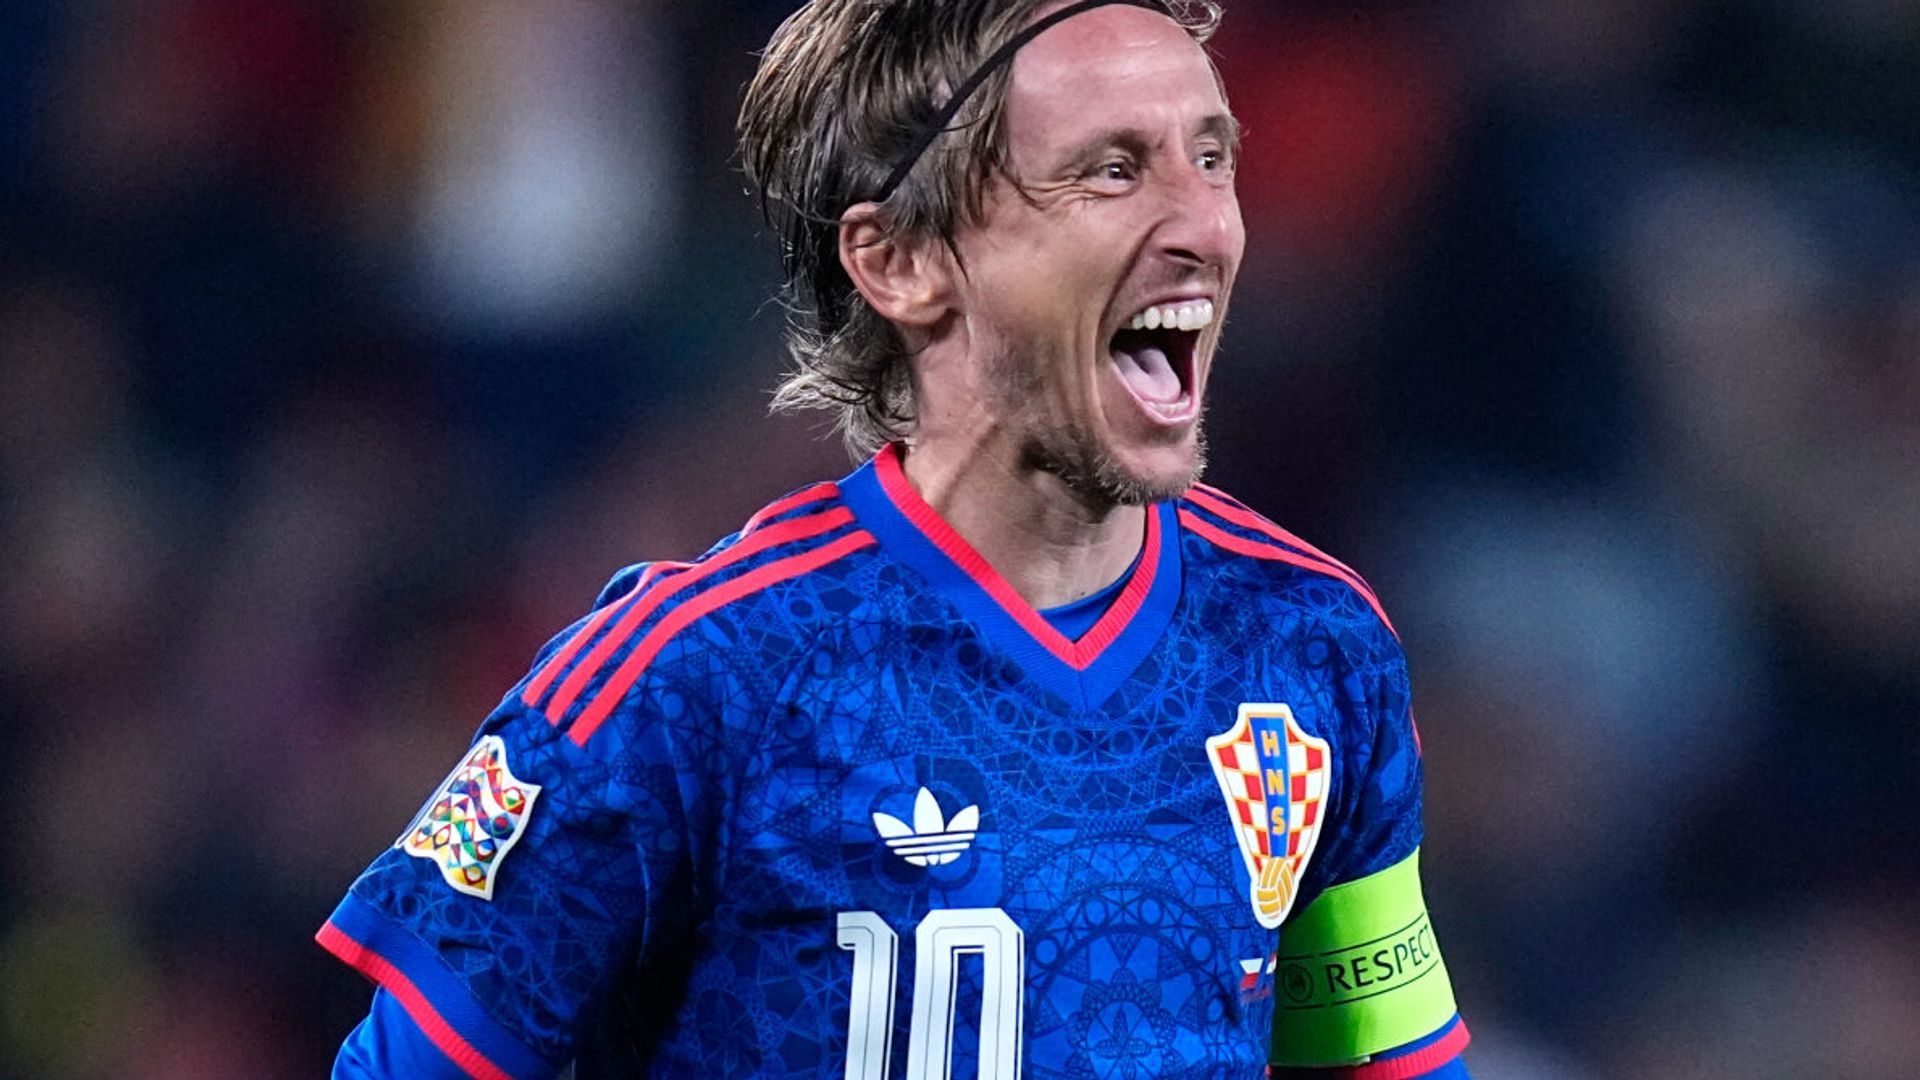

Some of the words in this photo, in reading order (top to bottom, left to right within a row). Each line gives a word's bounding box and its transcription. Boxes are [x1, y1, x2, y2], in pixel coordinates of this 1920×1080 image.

[1261, 730, 1286, 835] HNS
[837, 907, 1024, 1080] 10
[1325, 923, 1435, 993] RESPECT
